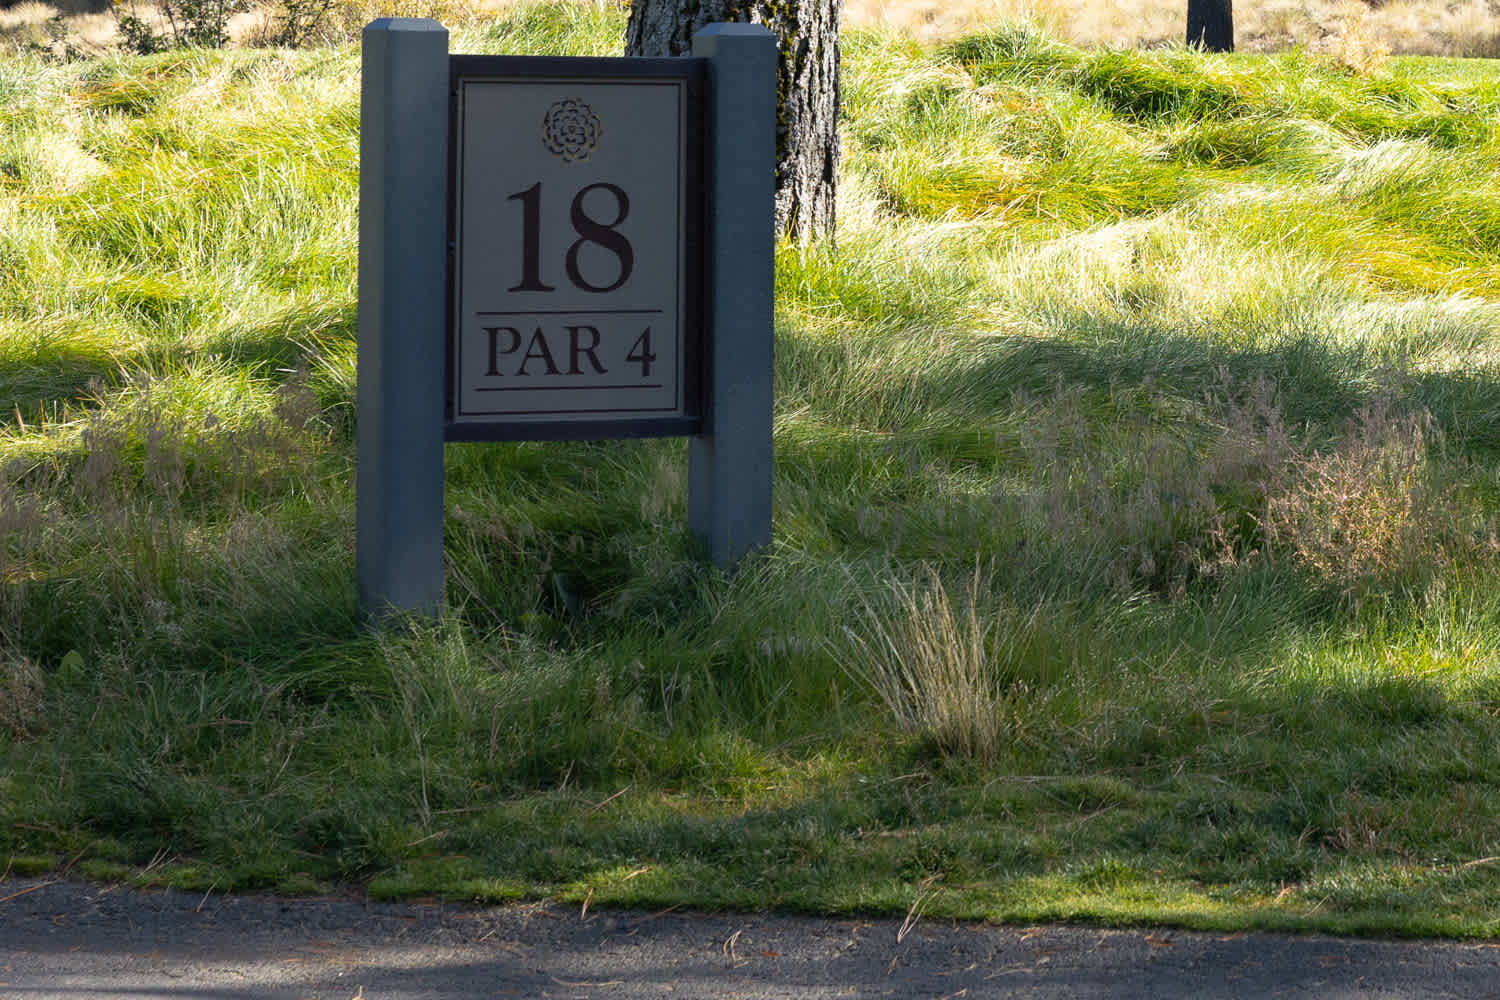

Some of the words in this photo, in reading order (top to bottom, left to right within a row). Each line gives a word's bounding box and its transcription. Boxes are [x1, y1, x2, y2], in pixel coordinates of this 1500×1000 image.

[507, 182, 634, 293] 18
[482, 326, 608, 377] PAR
[625, 326, 657, 377] 4
